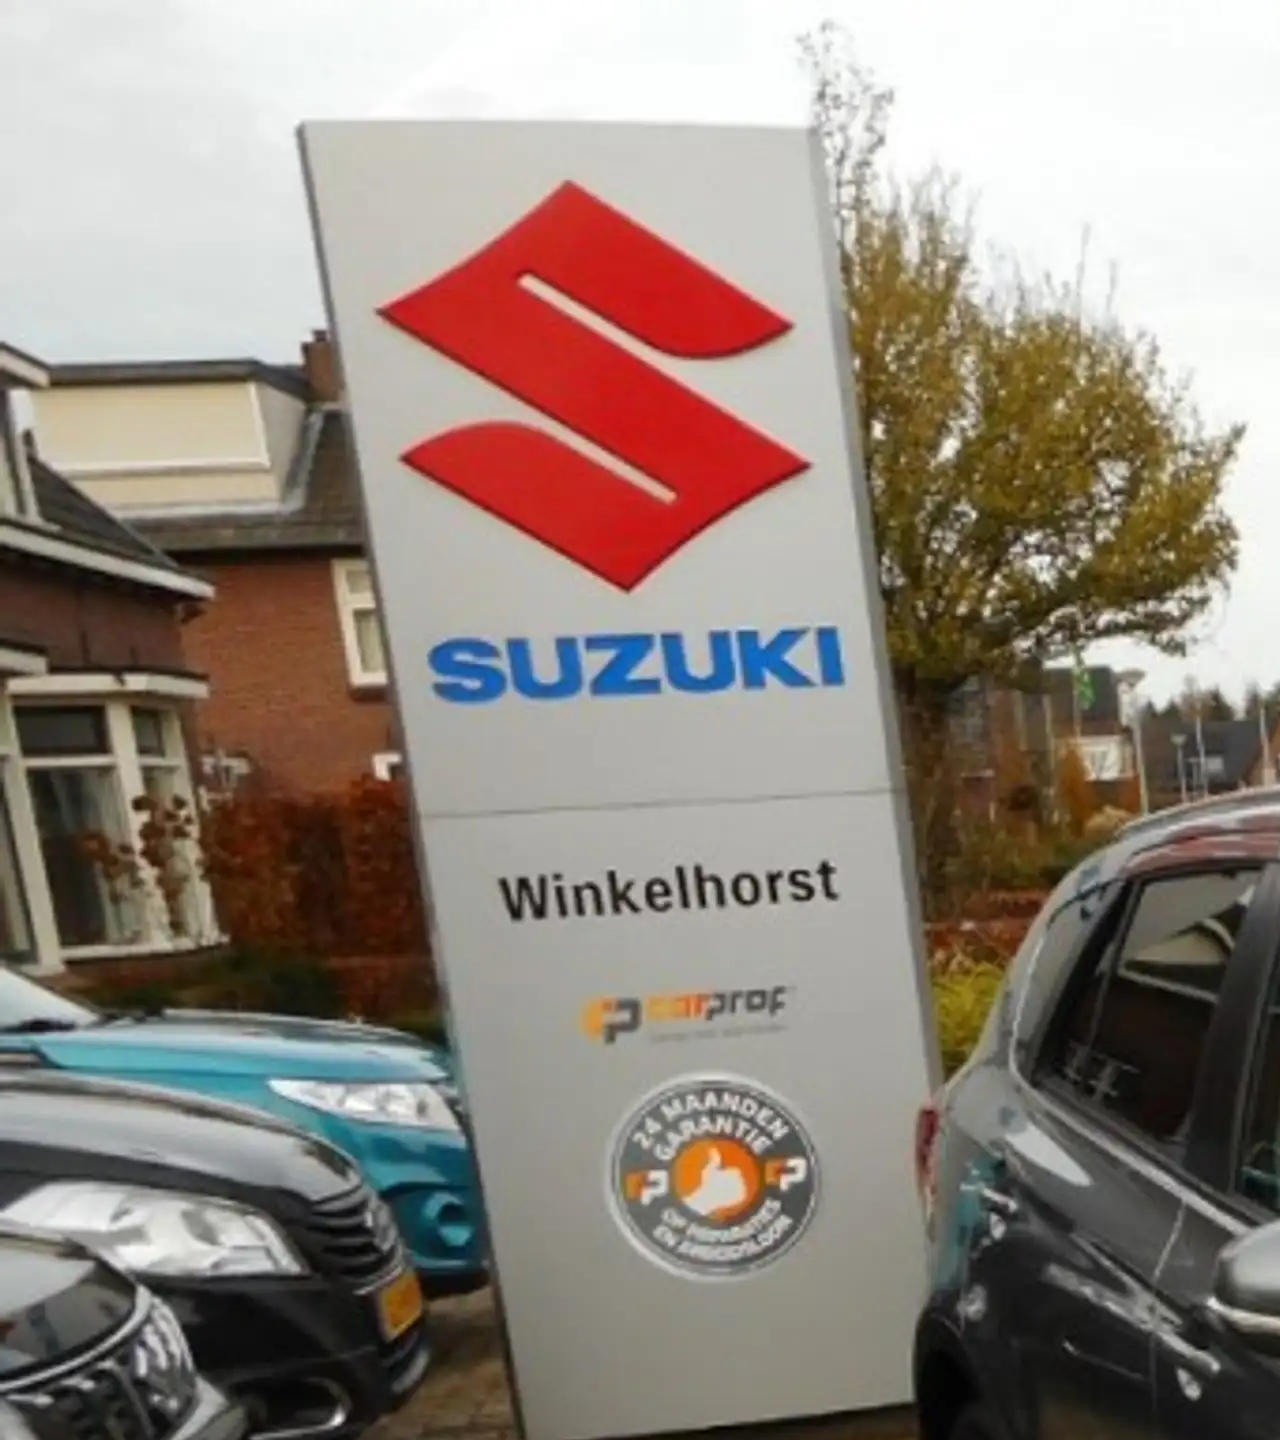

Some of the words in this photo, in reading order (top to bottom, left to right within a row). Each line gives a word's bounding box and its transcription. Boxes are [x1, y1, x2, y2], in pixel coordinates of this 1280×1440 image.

[428, 625, 845, 705] SUZUKI
[498, 859, 840, 922] Winkelhorst
[632, 1116, 662, 1150] 24
[660, 1091, 790, 1141] MAANDEN
[653, 1113, 776, 1161] GARANTIE
